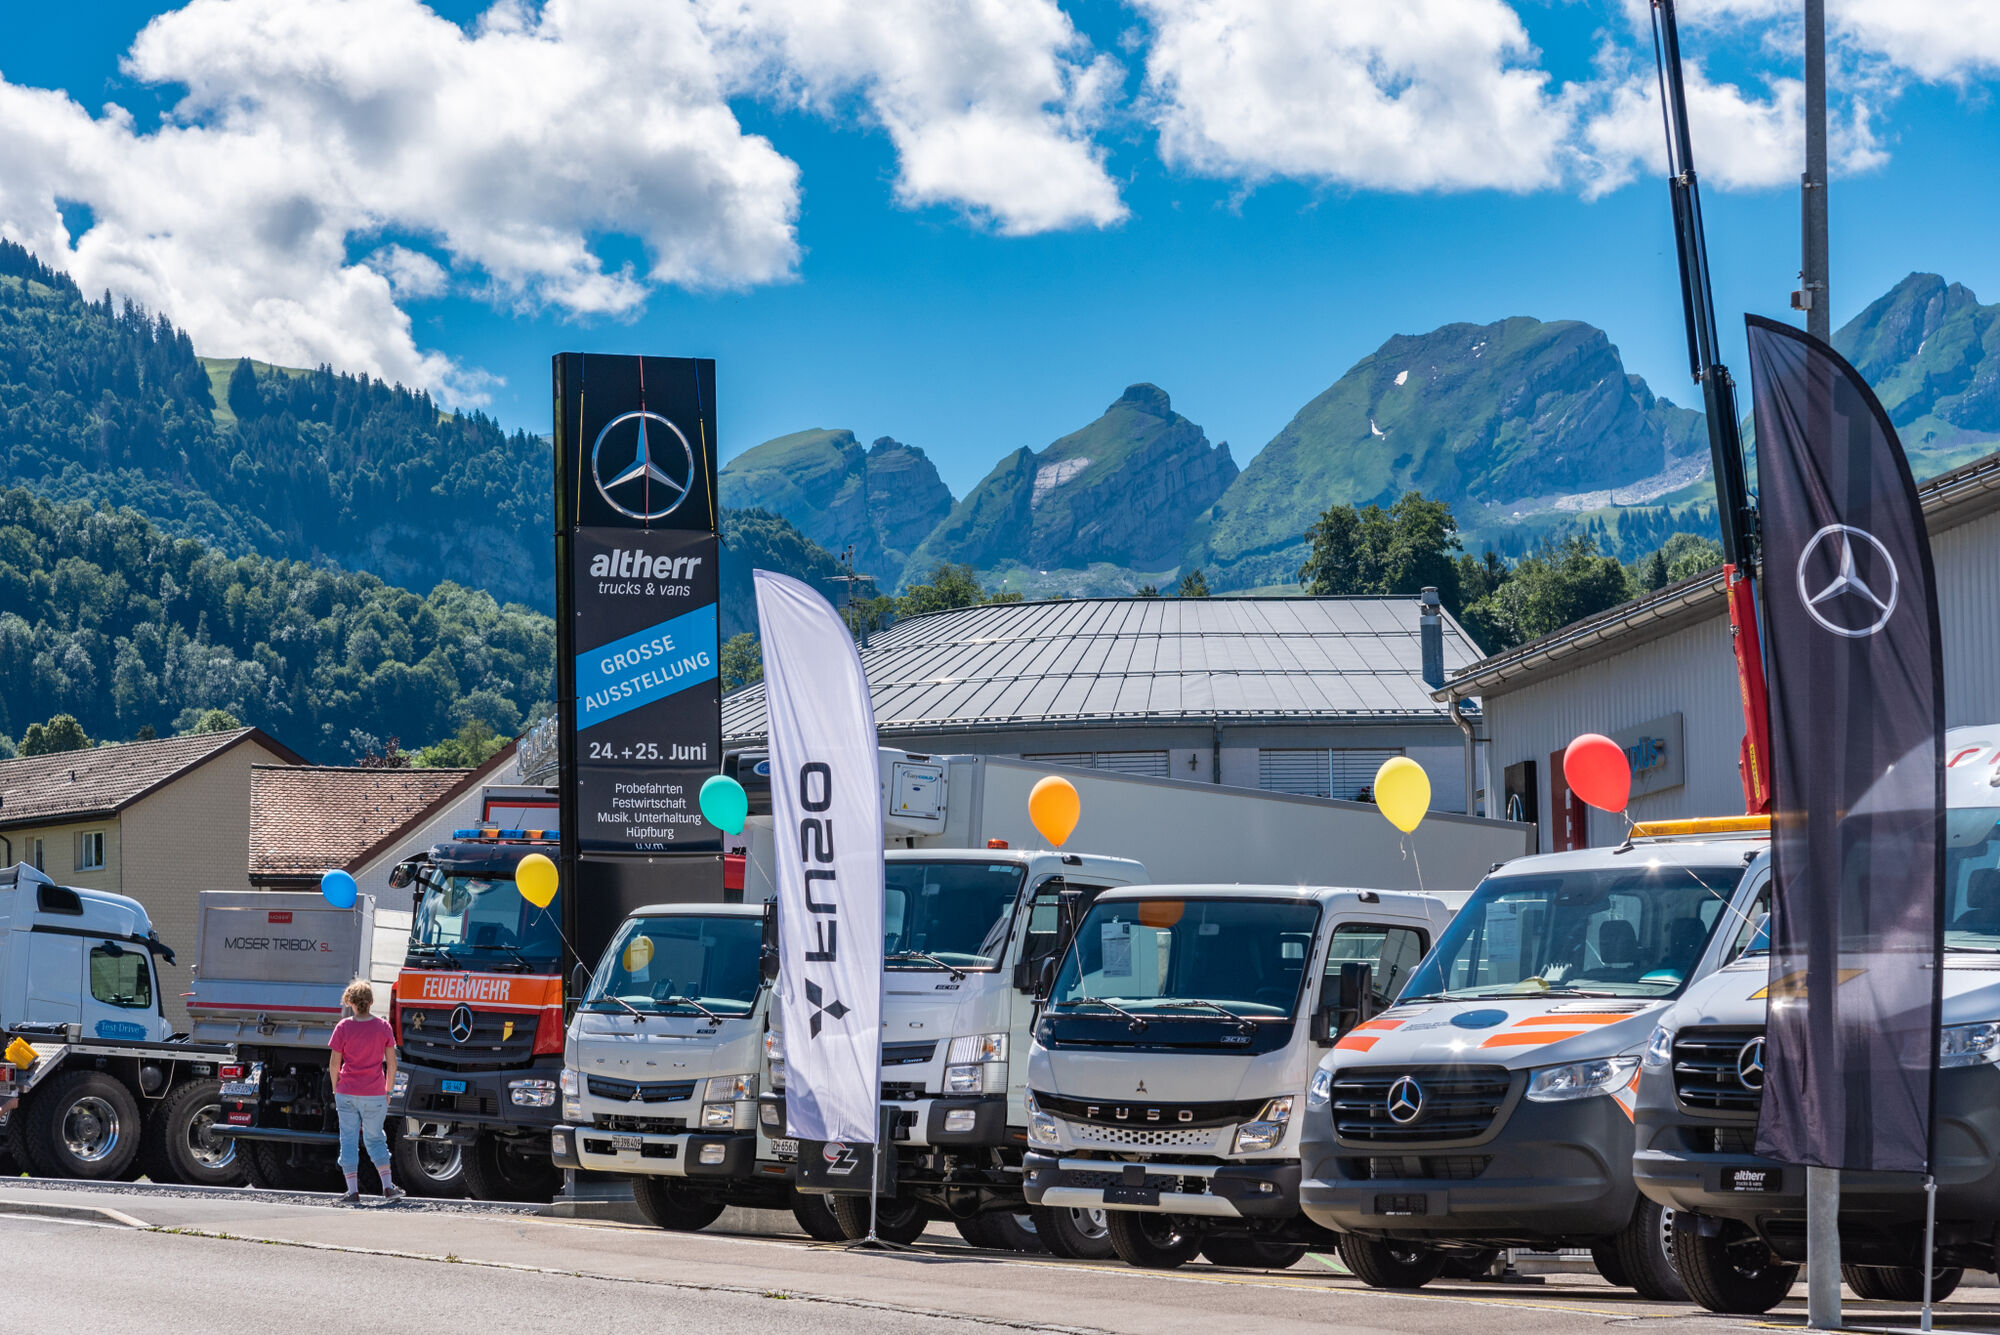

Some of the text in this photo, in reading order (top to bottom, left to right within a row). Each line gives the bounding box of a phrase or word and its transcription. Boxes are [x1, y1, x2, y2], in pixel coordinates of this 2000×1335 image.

[590, 549, 702, 580] altherr
[598, 581, 691, 597] trucks & vans
[600, 635, 676, 675] GROSSE
[585, 651, 710, 712] AUSSTELLUNG
[669, 743, 707, 761] Juni
[615, 783, 683, 794] Probefahrten
[612, 797, 687, 809] Festwirtschaft
[634, 812, 702, 826] Unterhaltung
[626, 827, 675, 840] Hüpfburg
[635, 842, 668, 850] u.v.m.
[224, 937, 333, 952] MOSER TRIBOX SL
[422, 977, 511, 1001] FEUERWEHR
[102, 1021, 140, 1033] Test Drive
[1087, 1106, 1194, 1122] FUSO
[1734, 1170, 1766, 1181] altherr
